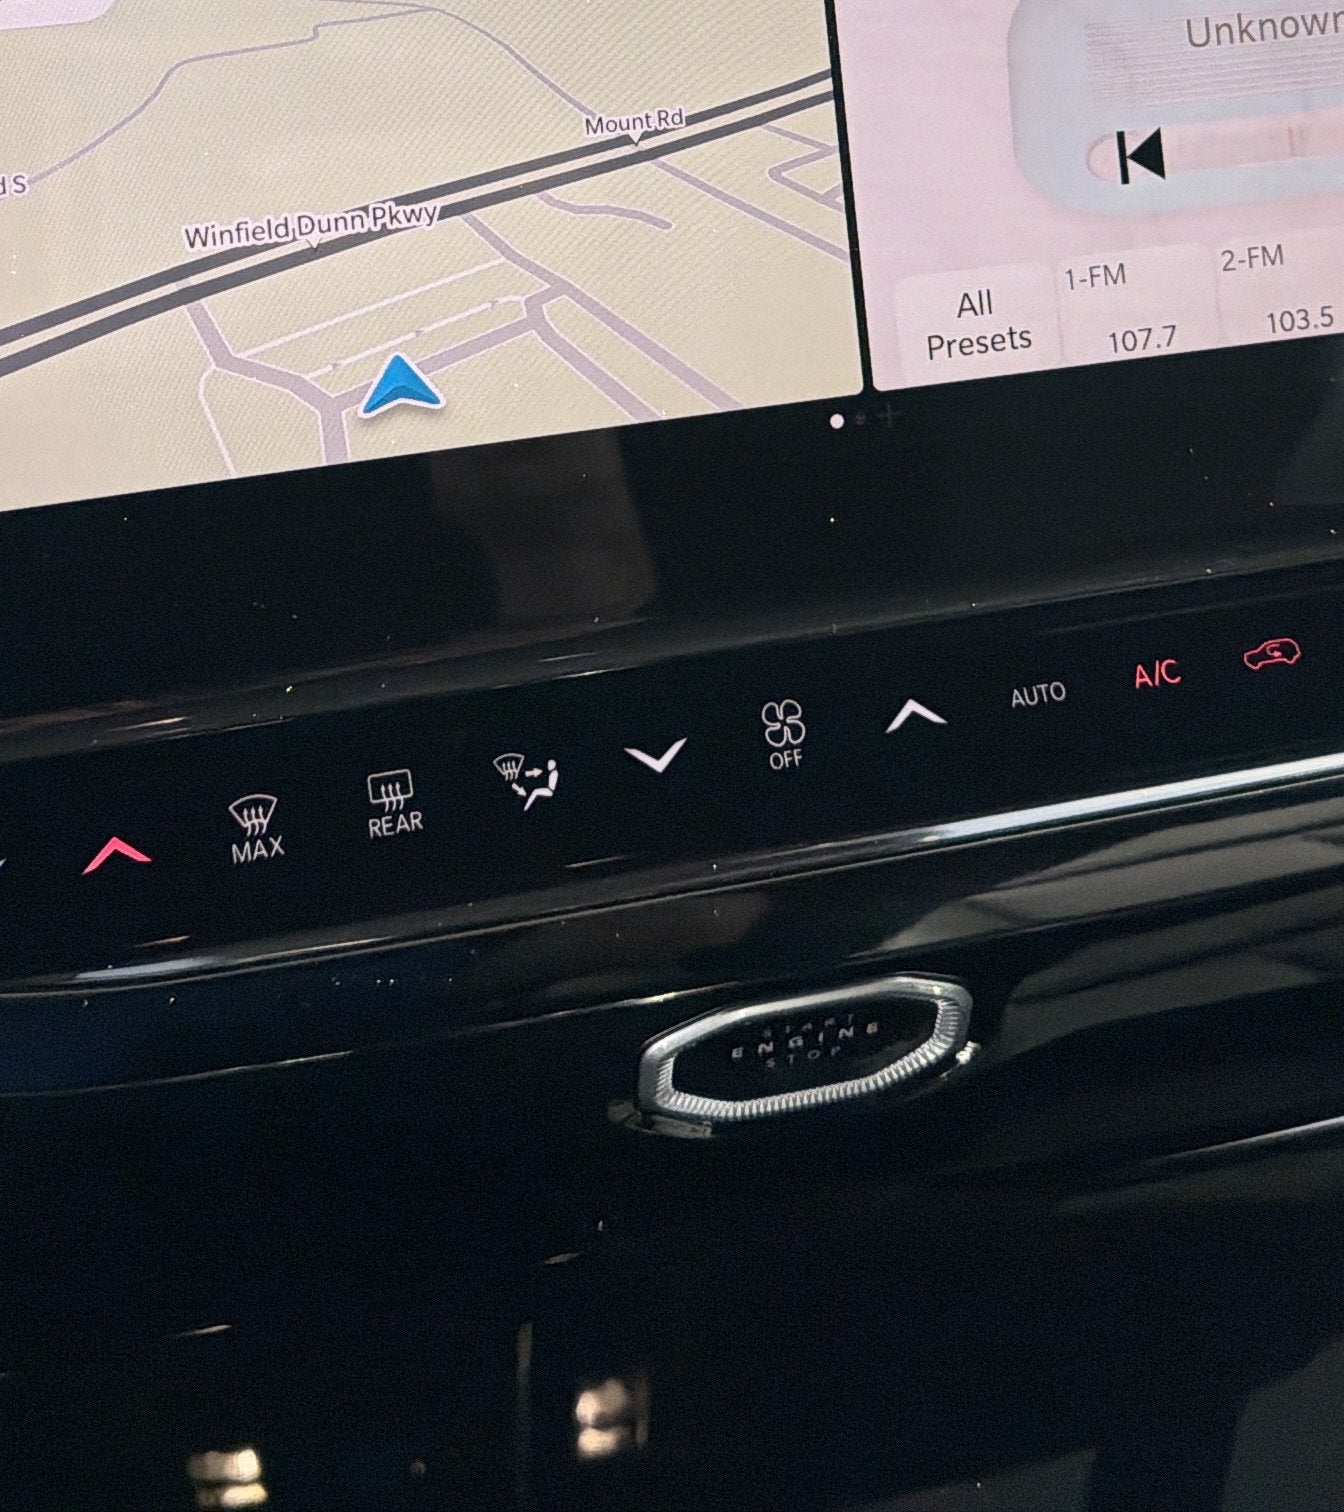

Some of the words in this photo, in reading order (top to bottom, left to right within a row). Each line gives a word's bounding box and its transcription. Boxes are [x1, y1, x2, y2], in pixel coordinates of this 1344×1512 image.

[586, 112, 653, 136] Mount
[656, 108, 684, 129] Rd
[13, 175, 27, 195] S
[185, 219, 292, 251] Winfield
[294, 208, 365, 240] Dunn
[369, 200, 440, 232] Pkwy
[1220, 243, 1286, 274] 2-FM
[1063, 262, 1127, 292] 1-FM
[956, 288, 994, 319] All
[1265, 305, 1335, 334] 103.5
[926, 324, 1034, 362] Presets
[1107, 324, 1178, 355] 107.7
[1133, 659, 1183, 689] A/C
[1011, 682, 1067, 709] AUTO
[768, 748, 804, 771] OFF
[367, 810, 424, 840] REAR
[231, 836, 285, 864] MAX
